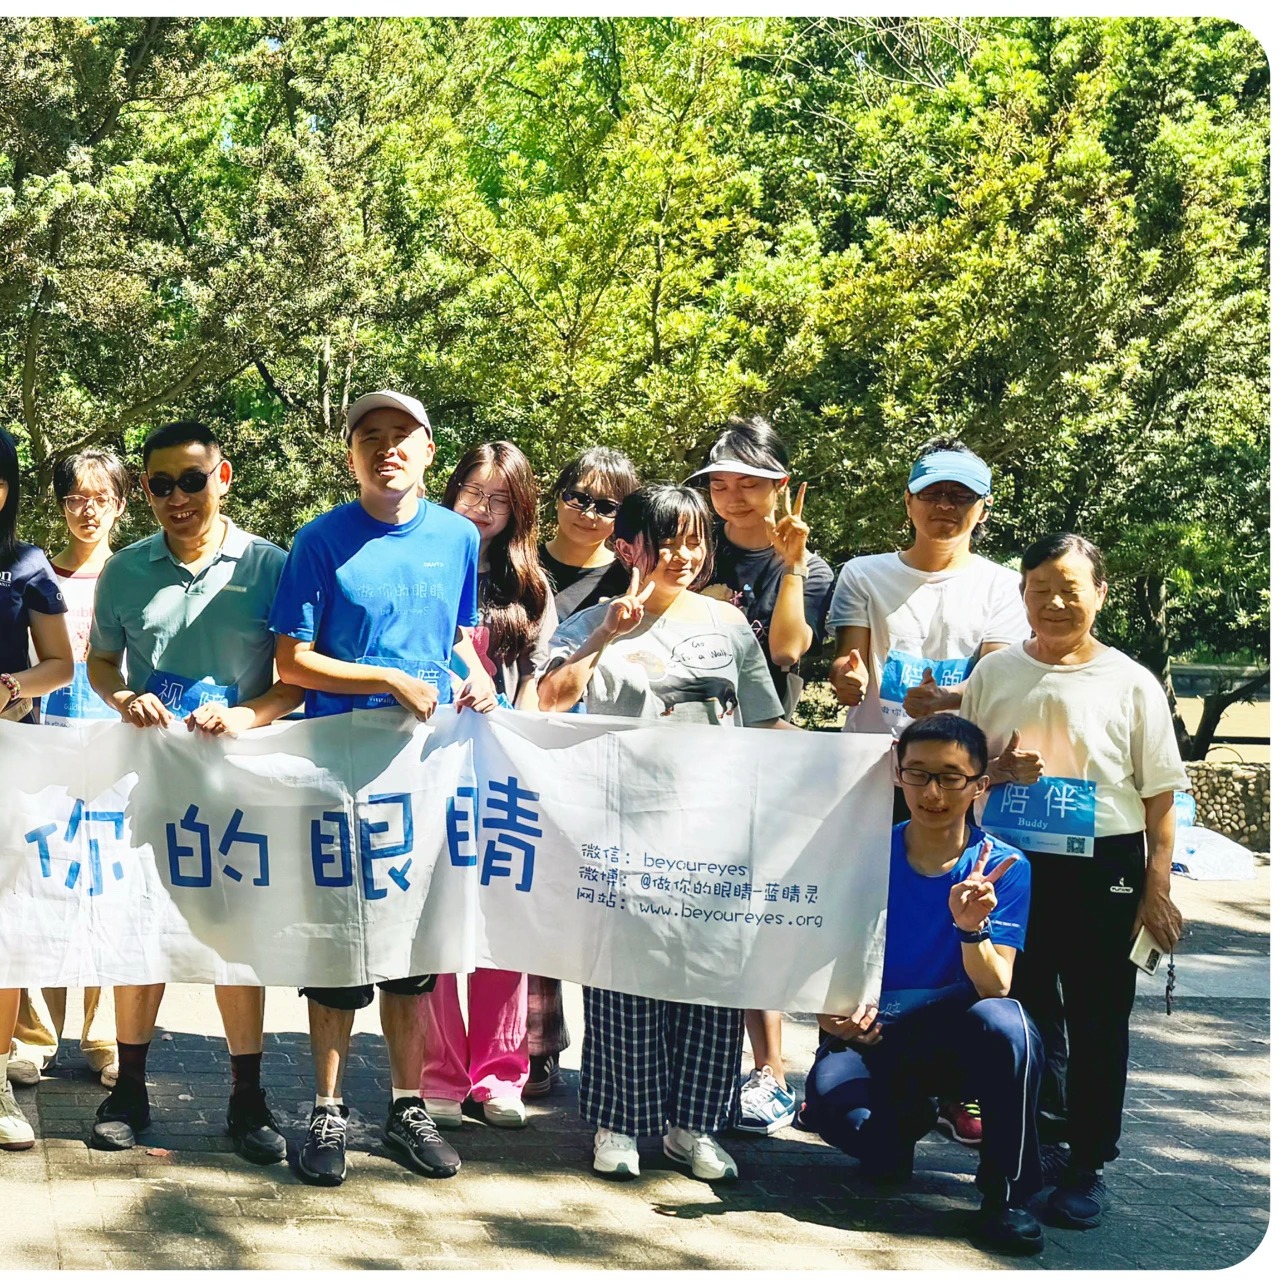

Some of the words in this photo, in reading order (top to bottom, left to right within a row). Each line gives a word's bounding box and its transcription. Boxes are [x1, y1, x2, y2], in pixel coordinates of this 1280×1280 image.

[1000, 783, 1078, 819] 陪伴
[1017, 816, 1048, 830] Buddy
[643, 852, 749, 877] beyoureyes
[639, 902, 824, 928] www.beyoureyes.org
